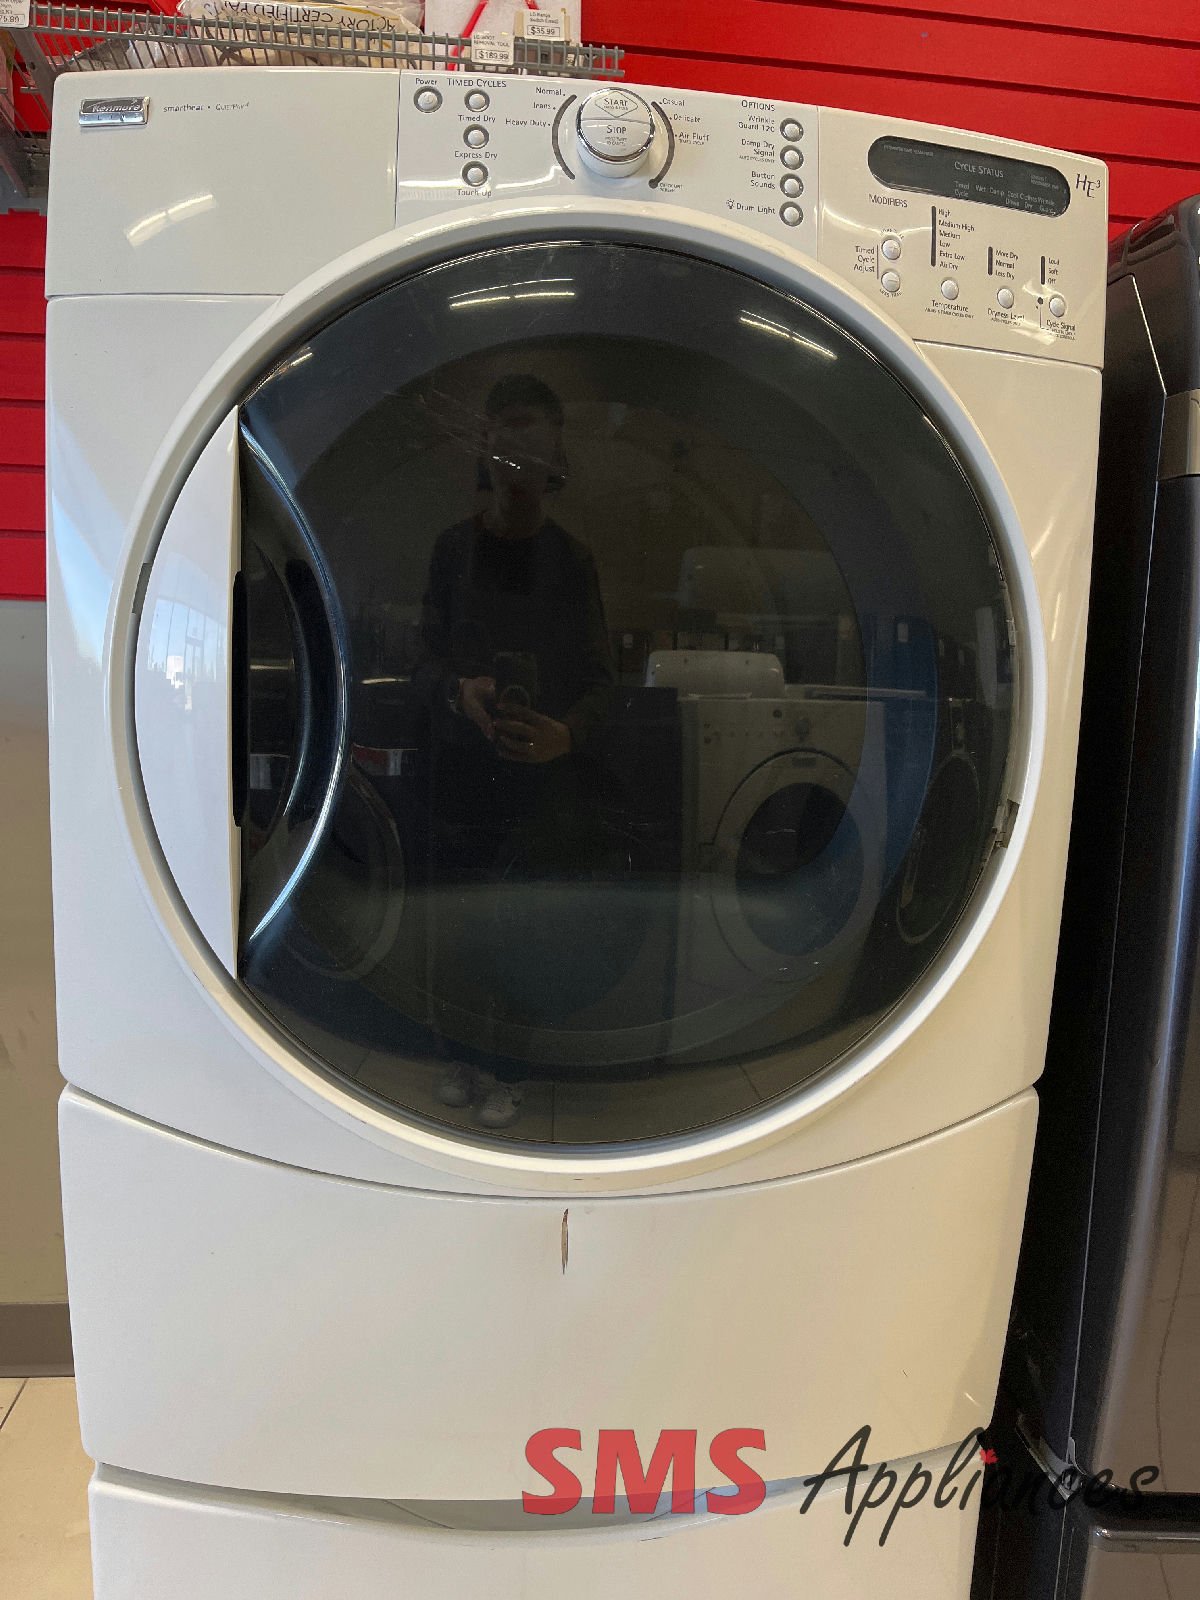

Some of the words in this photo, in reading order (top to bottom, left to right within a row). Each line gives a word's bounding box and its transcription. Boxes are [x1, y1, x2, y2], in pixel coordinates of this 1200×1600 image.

[530, 26, 556, 36] $35.99
[415, 77, 438, 86] Power
[447, 78, 473, 87] TIMED
[476, 79, 507, 88] CYCLES
[535, 86, 562, 96] Normal
[603, 97, 628, 107] START
[662, 98, 685, 107] Casual
[741, 99, 776, 112] OPTIONS
[92, 103, 141, 113] Kenmore
[458, 114, 481, 123] Timed
[483, 114, 496, 124] Dry
[505, 118, 528, 128] Heavy
[530, 119, 547, 128] Duty
[673, 113, 701, 123] Delicate
[748, 114, 775, 125] Wrinkle
[738, 121, 759, 131] Guard
[678, 131, 689, 140] Air
[692, 132, 710, 142] Fluff
[741, 138, 762, 148] Damp
[763, 140, 776, 151] Dry
[454, 150, 482, 160] Express
[485, 151, 498, 160] Dry
[753, 148, 776, 158] Signal
[954, 161, 977, 174] CYCLE
[978, 165, 1004, 178] STATUS
[751, 170, 775, 180] Button
[750, 179, 776, 190] Sounds
[975, 184, 987, 193] Wet
[457, 188, 479, 197] Touch
[481, 189, 492, 198] Up
[954, 189, 969, 198] Cycle
[868, 193, 909, 208] MODIFIERS
[736, 202, 755, 212] Drum
[757, 205, 776, 216] Light
[938, 207, 951, 218] High
[938, 219, 961, 230] Medium
[961, 223, 975, 233] High
[938, 229, 961, 240] Medium
[939, 239, 951, 248] Low
[855, 245, 875, 255] Timed
[995, 249, 1009, 258] More
[1009, 251, 1019, 261] Dry
[857, 254, 875, 265] Cycle
[954, 252, 966, 261] Low
[1048, 257, 1060, 266] Loud
[853, 263, 875, 274] Adjust
[995, 259, 1015, 270] Normal
[1006, 271, 1015, 280] Dry
[1048, 267, 1059, 276] Soft
[1047, 277, 1057, 285] Off
[931, 299, 969, 313] Temperature
[1046, 319, 1060, 329] Cycle
[1060, 321, 1076, 332] Signal
